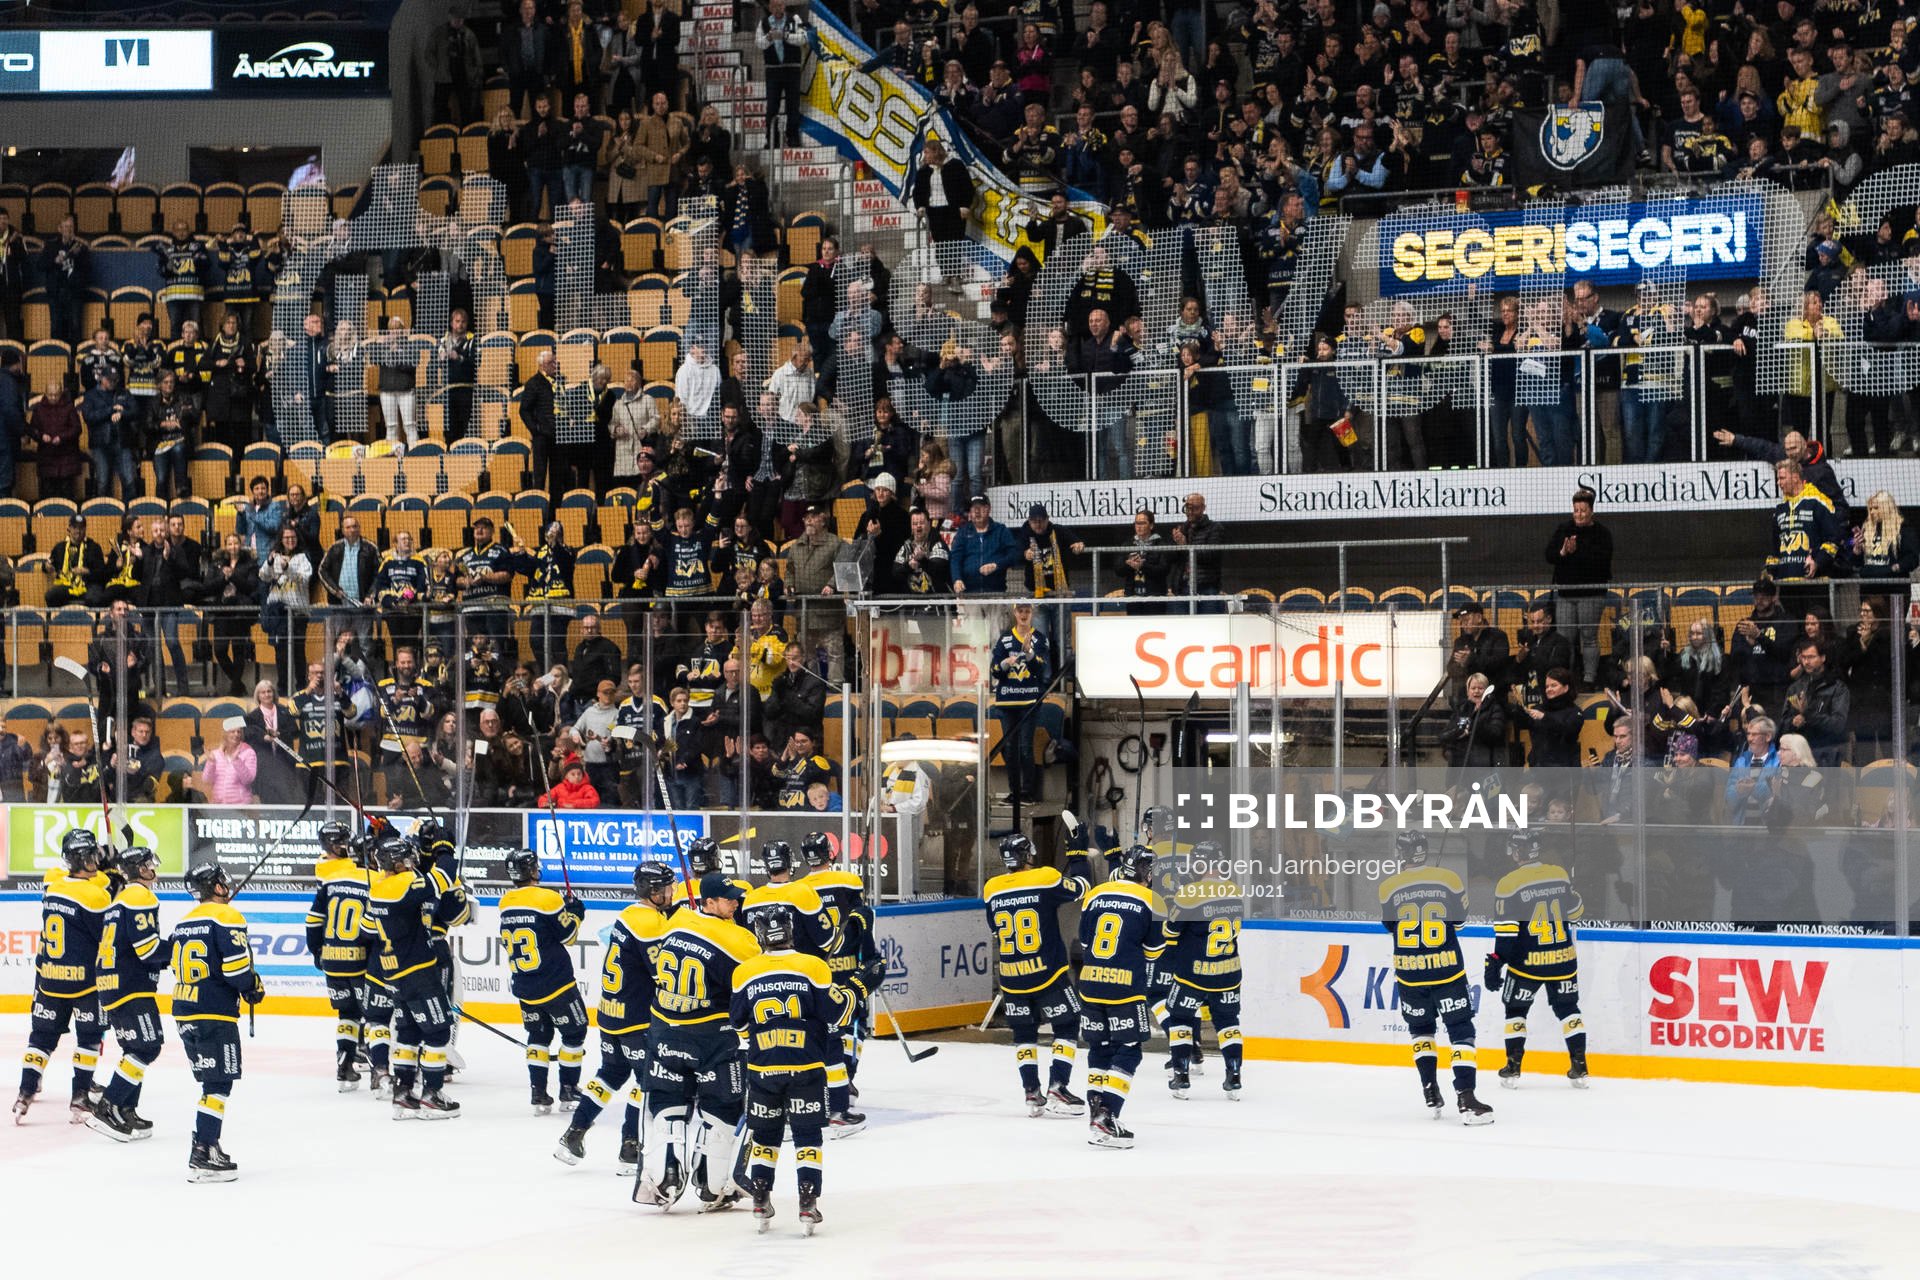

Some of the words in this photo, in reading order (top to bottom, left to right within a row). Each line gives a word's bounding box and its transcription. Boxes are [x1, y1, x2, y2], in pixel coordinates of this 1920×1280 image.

[783, 149, 813, 161] MAXI
[798, 166, 829, 177] MAXI
[855, 182, 884, 194] MAXI
[861, 198, 890, 210] MAXI
[872, 215, 901, 227] MAXI
[1259, 478, 1507, 513] SkandiaMäklarna
[1134, 624, 1382, 689] Scandic
[568, 821, 620, 846] TMG
[571, 852, 606, 861] TABERG
[609, 852, 639, 862] MEDIA
[996, 896, 1039, 908] Husqvarna
[1400, 890, 1446, 902] Husqvarna
[1095, 899, 1142, 913] Husqvarna
[134, 912, 155, 931] 34
[325, 896, 364, 941] 10
[1397, 901, 1447, 948] 26
[1528, 898, 1567, 945] 41
[995, 908, 1041, 955] 28
[1650, 920, 1735, 933] KONRADSSONS
[1776, 924, 1864, 936] KONRADSSONS
[1091, 912, 1123, 959] 8
[655, 949, 707, 1000] 60
[754, 981, 809, 995] Husqvarna
[1648, 955, 1829, 1025] SEW
[1005, 1002, 1031, 1016] JP.se
[1440, 997, 1467, 1014] JP.se
[1108, 1016, 1135, 1032] JP.se
[756, 1028, 806, 1050] IKONEN
[1650, 1021, 1825, 1052] EURODRIVE
[1413, 1041, 1431, 1053] GA
[1017, 1049, 1032, 1061] GA
[750, 1102, 783, 1119] JP.se
[789, 1098, 822, 1115] JP.se
[752, 1146, 773, 1159] GA
[797, 1149, 817, 1161] GA
